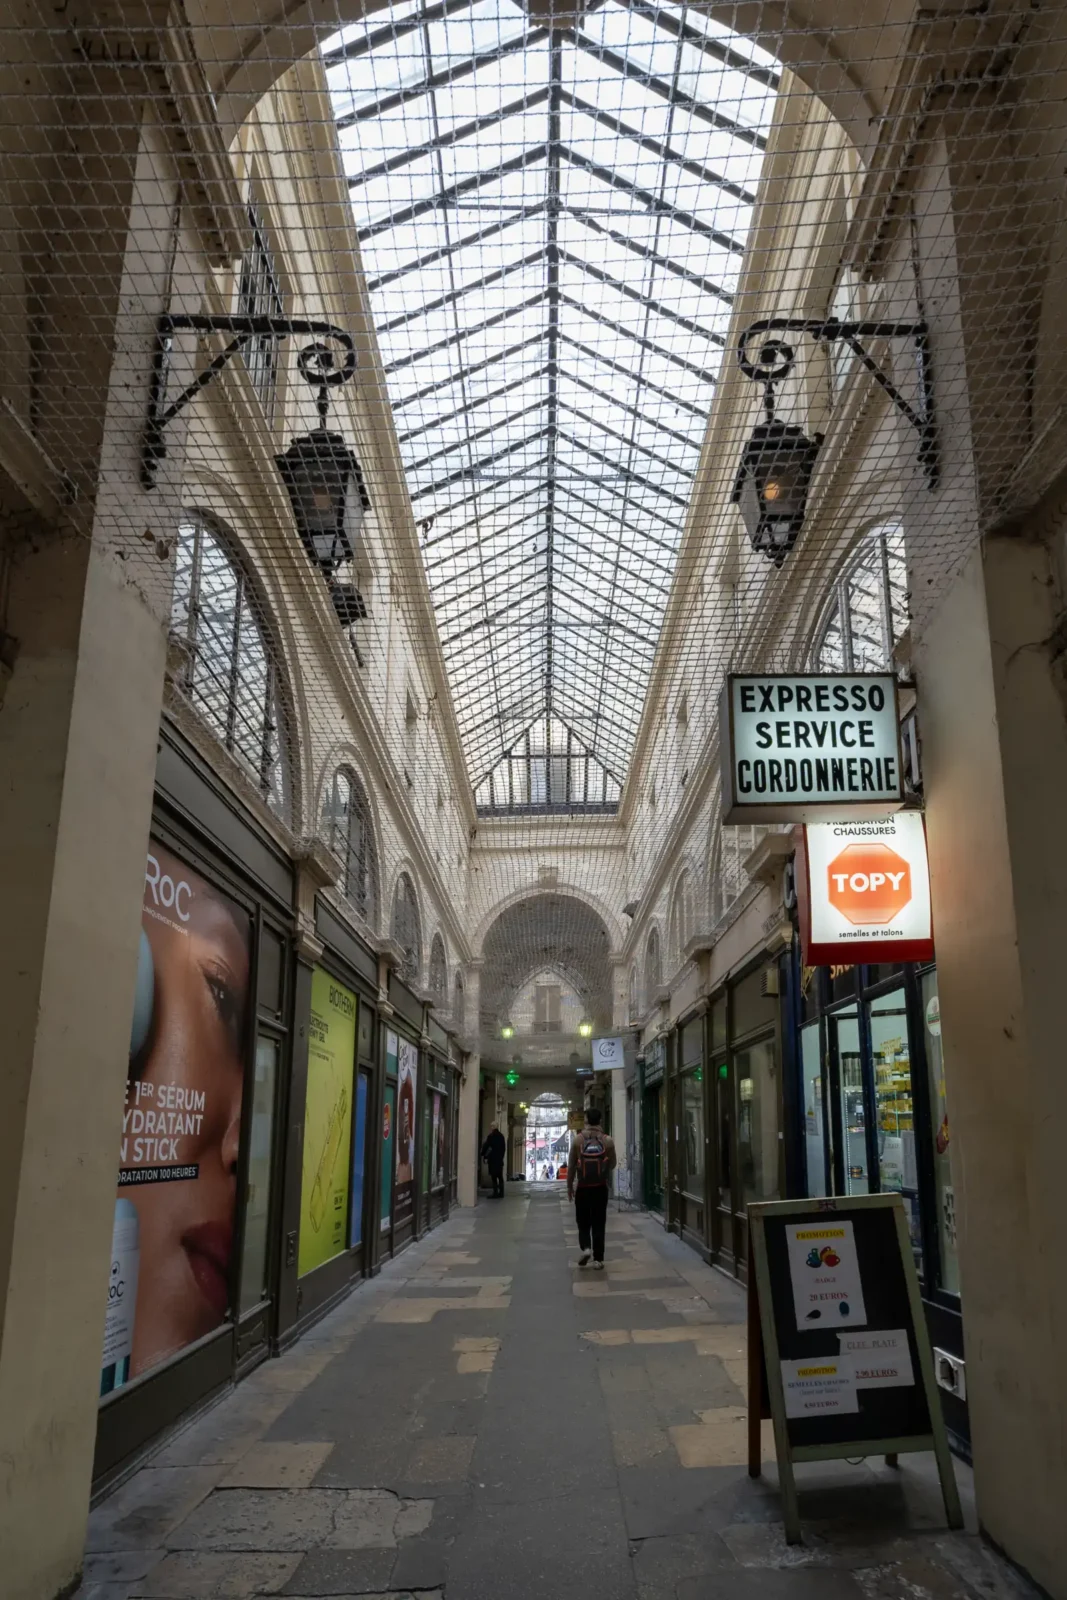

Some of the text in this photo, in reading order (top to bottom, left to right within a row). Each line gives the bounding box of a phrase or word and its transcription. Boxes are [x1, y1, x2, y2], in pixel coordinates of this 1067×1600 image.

[739, 684, 885, 712] EXPRESSO
[755, 720, 875, 749] SERVICE
[737, 757, 897, 793] CORDONNERIE
[833, 827, 896, 836] CHAUSSURES
[832, 872, 906, 893] TOPY
[839, 930, 869, 938] semelles
[881, 928, 903, 936] talons
[157, 1081, 205, 1111] SÉRUM
[133, 1138, 180, 1162] STICK
[159, 1168, 171, 1179] 100
[171, 1166, 197, 1178] HEURES
[796, 1229, 845, 1239] PROMOTION
[819, 1292, 848, 1301] EUROS
[871, 1368, 898, 1377] EUROS
